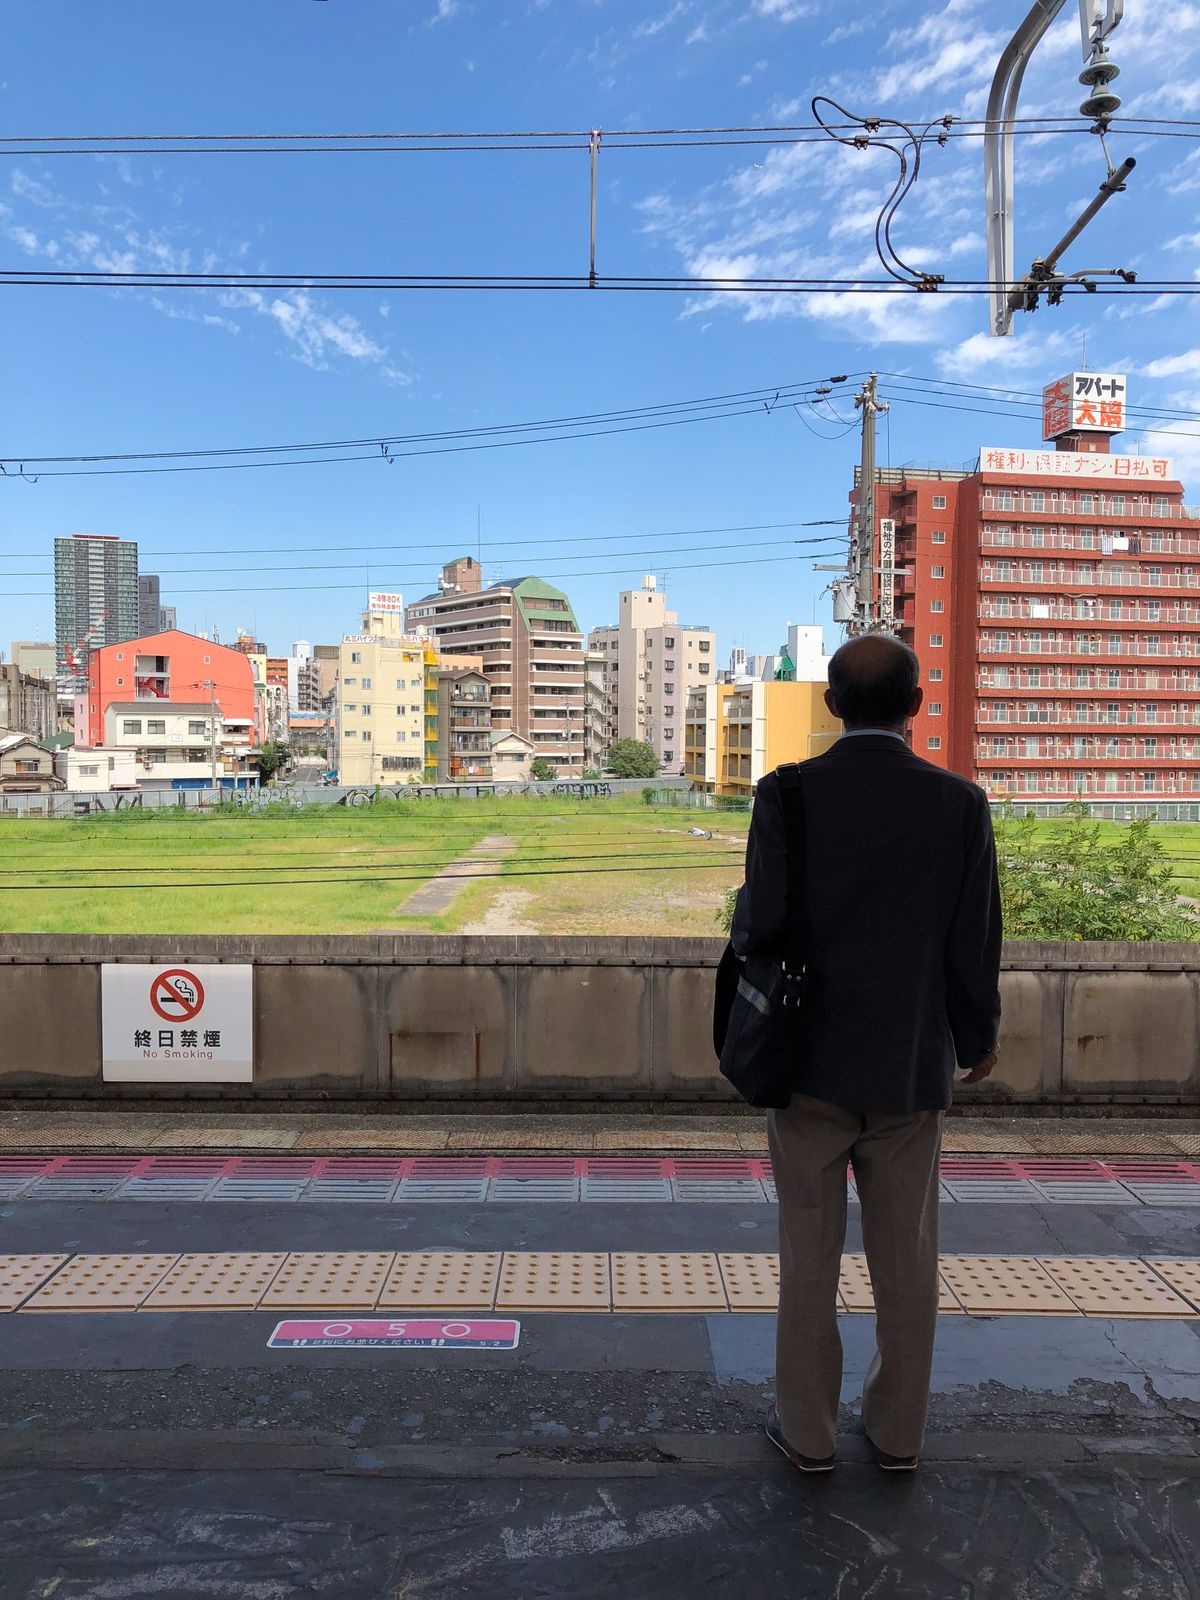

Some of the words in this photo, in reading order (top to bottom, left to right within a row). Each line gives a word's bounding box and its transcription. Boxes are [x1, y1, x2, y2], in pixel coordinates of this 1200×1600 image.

[1075, 377, 1125, 398] アパート
[134, 1029, 221, 1048] 終日禁煙
[143, 1049, 158, 1059] No
[164, 1049, 213, 1060] Smoking
